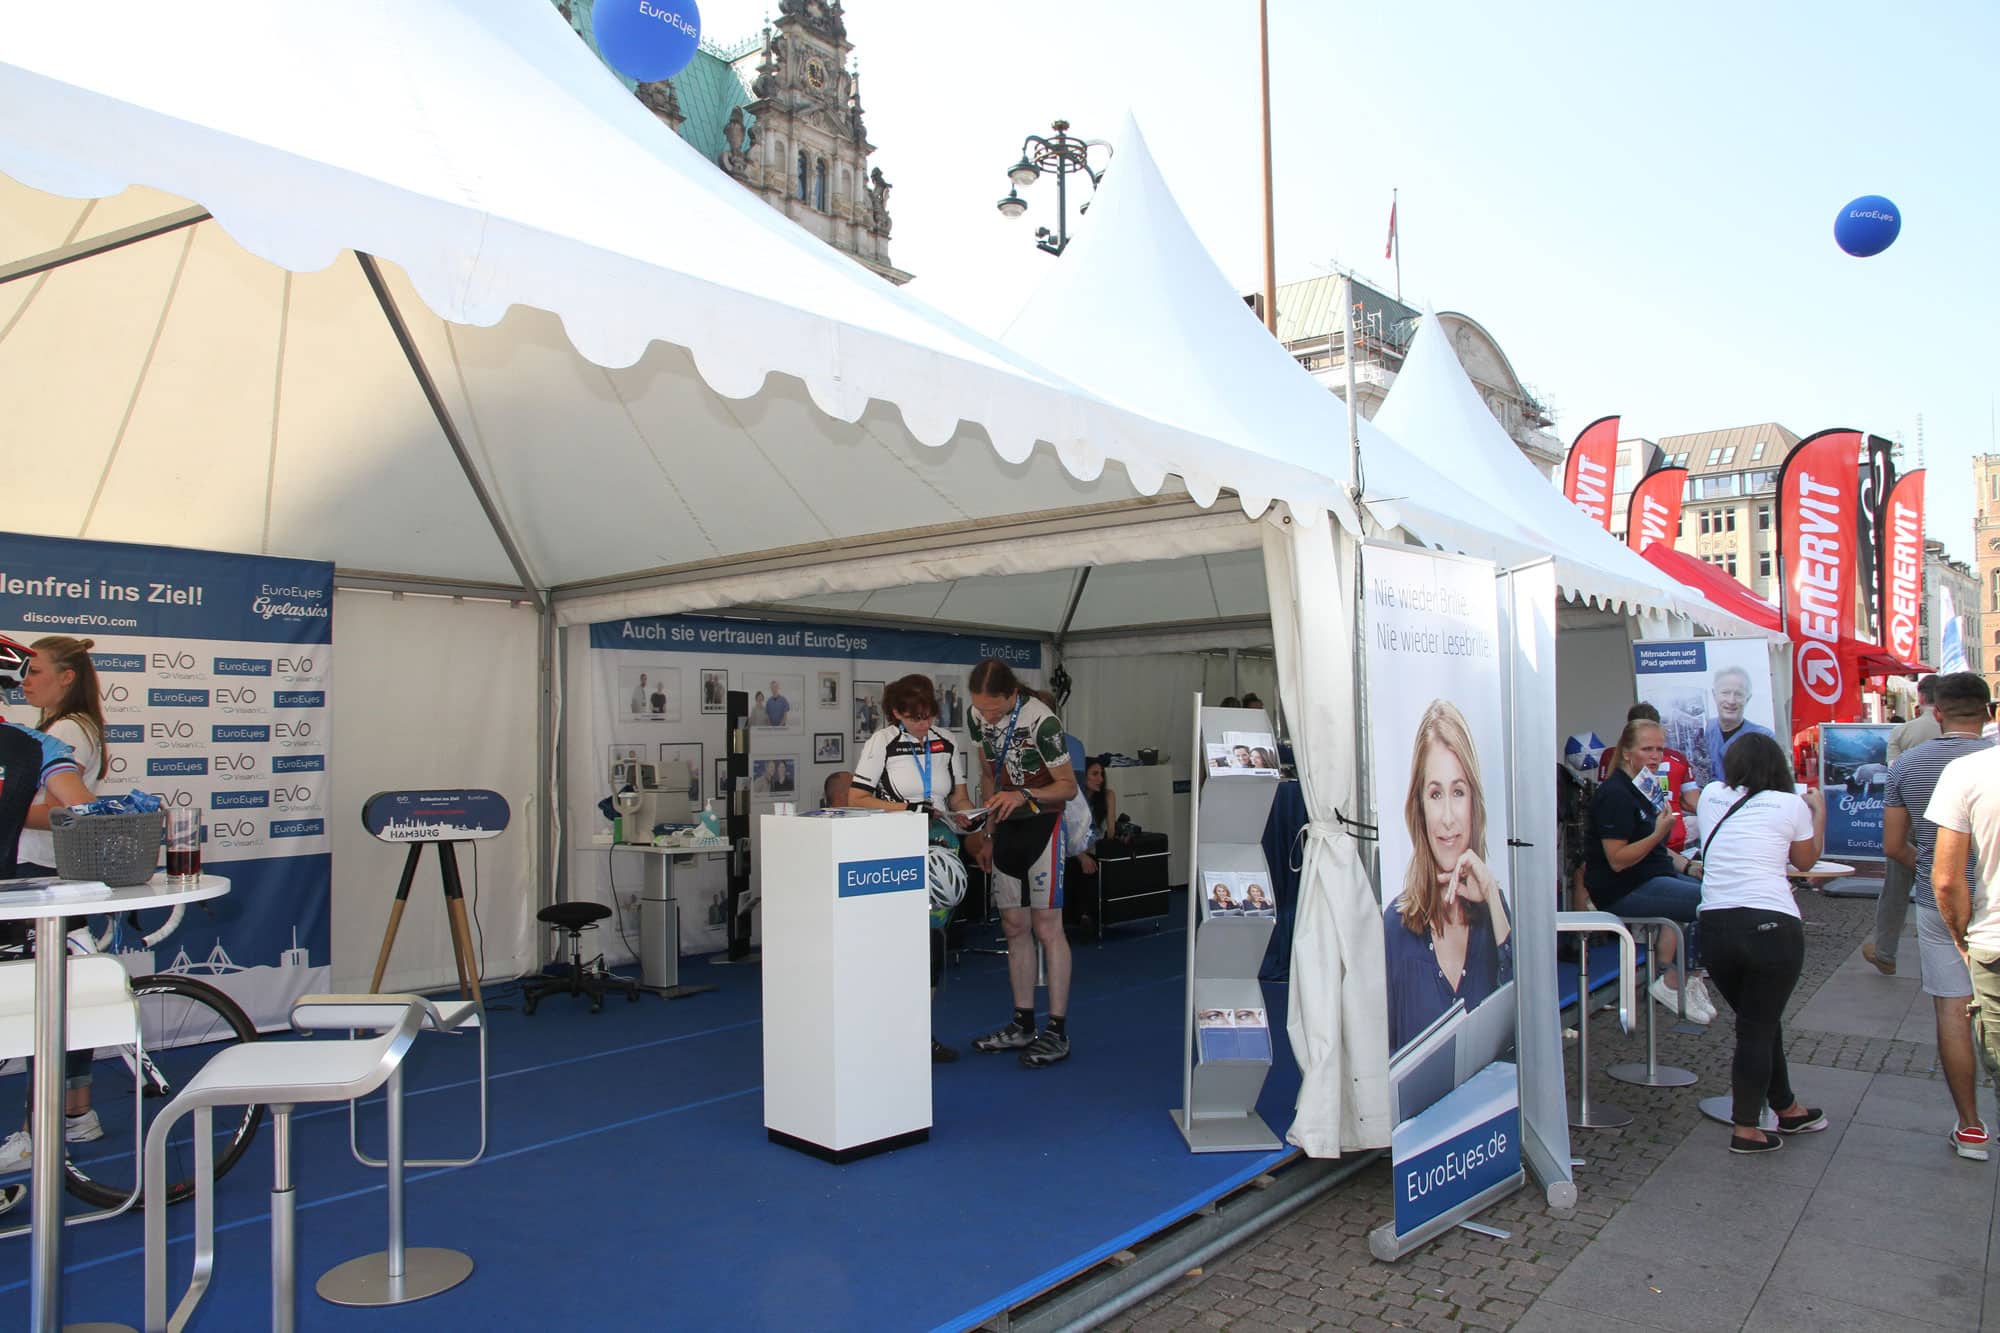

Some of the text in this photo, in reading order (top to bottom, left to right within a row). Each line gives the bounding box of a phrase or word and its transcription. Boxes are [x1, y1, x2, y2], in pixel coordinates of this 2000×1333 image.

[640, 1, 696, 38] EuroEyes
[1850, 209, 1894, 222] EuroEyes
[1575, 454, 1607, 528] RVIT
[1640, 495, 1668, 551] VIT
[1799, 472, 1840, 643] ENERVIT
[1892, 502, 1918, 617] ENERVIT
[0, 573, 202, 606] lenfrei ins Ziel!
[262, 584, 323, 600] EuroEyes
[1375, 578, 1395, 607] Nie
[252, 596, 328, 620] Cyclassics
[23, 612, 137, 627] discoverEVO.com
[622, 621, 868, 651] Auch sie vertrauen auf EuroEyes
[1377, 621, 1397, 651] Nie
[1400, 624, 1439, 654] wieder
[152, 651, 195, 669] EVO
[980, 643, 1031, 662] EuroEyes
[1640, 649, 1681, 658] Mitmachen
[219, 662, 267, 673] EuroEyes
[277, 656, 313, 673] EVO
[1641, 659, 1657, 667] iPad
[153, 693, 204, 703] EuroEyes
[216, 686, 256, 704] EVO
[278, 695, 321, 704] EuroEyes
[104, 729, 138, 739] oEyes
[151, 720, 194, 738] EVO
[217, 729, 265, 739] EuroEyes
[275, 720, 311, 738] EVO
[152, 761, 203, 772] EuroEyes
[215, 753, 255, 771] EVO
[277, 759, 320, 769] EuroEyes
[216, 795, 265, 805] EuroEyes
[274, 784, 311, 803] EVO
[214, 818, 255, 837] EVO
[274, 823, 320, 833] EuroEyes
[1851, 819, 1876, 827] ohne
[847, 867, 918, 887] EuroEyes
[1407, 1130, 1507, 1202] EuroEyes.de
